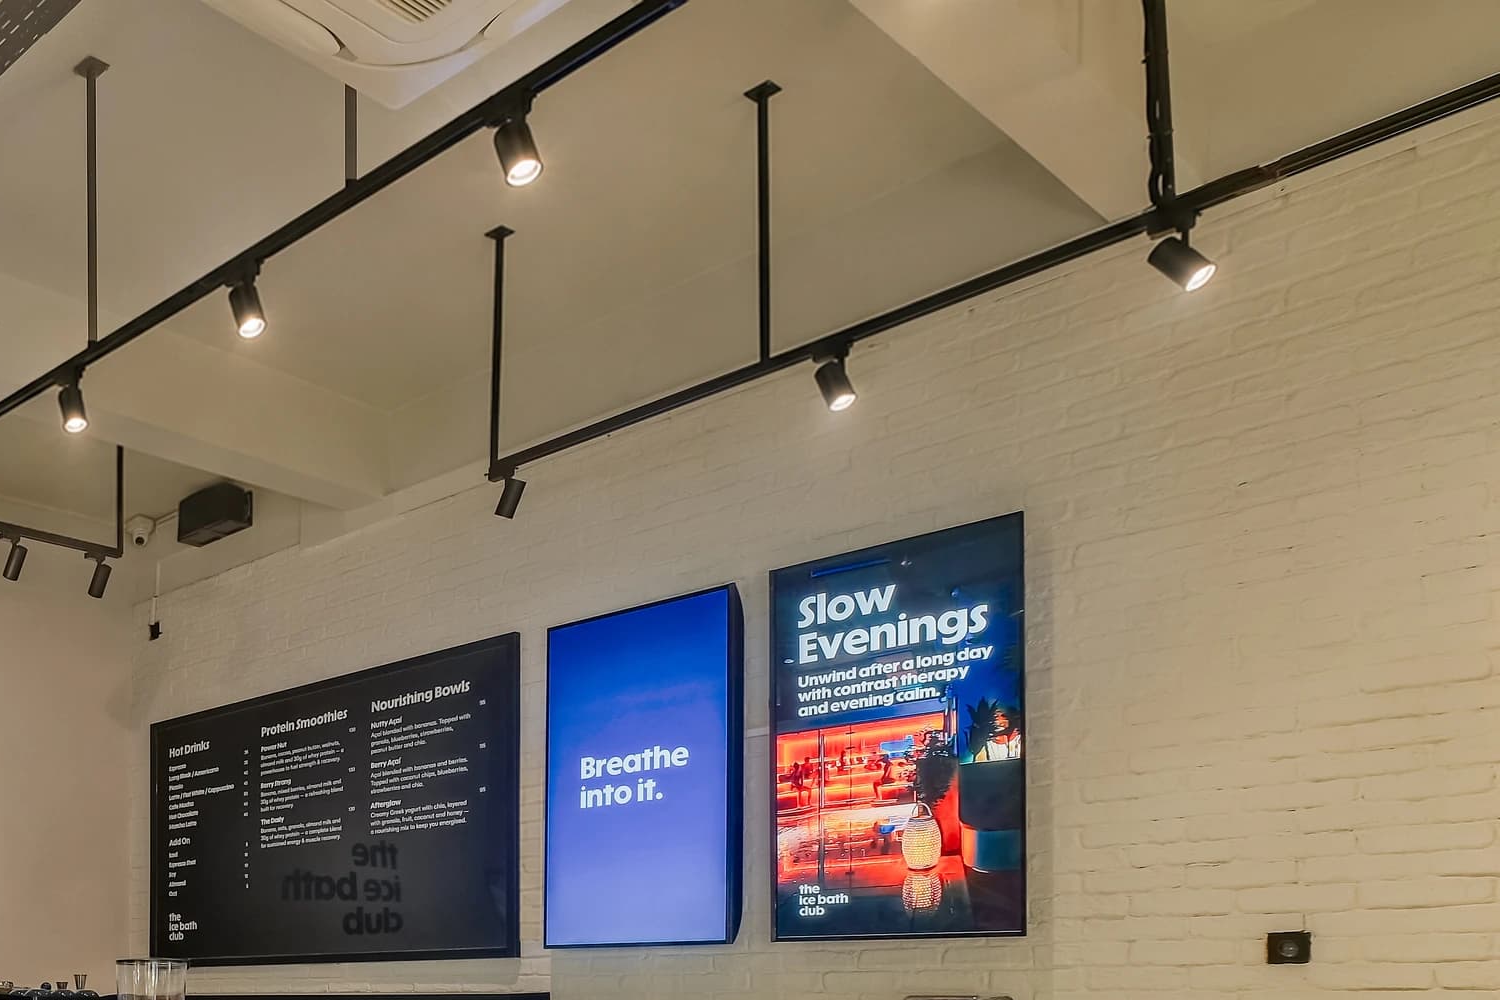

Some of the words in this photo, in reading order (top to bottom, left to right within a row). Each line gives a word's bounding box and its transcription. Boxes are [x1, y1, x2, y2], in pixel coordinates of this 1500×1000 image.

[797, 584, 896, 629] Slow
[799, 604, 989, 665] Evenings
[798, 666, 857, 687] Unwind
[858, 662, 900, 677] after
[902, 659, 914, 670] a
[916, 652, 954, 668] long
[957, 645, 993, 661] day
[798, 686, 831, 702] with
[833, 677, 899, 696] contrast
[900, 665, 970, 686] therapy
[371, 689, 433, 712] Nourishing
[434, 680, 470, 698] Bowls
[798, 701, 829, 717] and
[830, 692, 895, 709] evening
[896, 686, 941, 702] calm.
[261, 721, 295, 737] Protein
[296, 709, 348, 730] Smoothies
[371, 721, 387, 729] Nutty
[169, 746, 183, 758] Hot
[184, 740, 210, 755] Drinks
[581, 746, 689, 779] Breathe
[580, 784, 632, 808] into
[637, 778, 663, 802] it.
[370, 800, 401, 809] Afterglow
[169, 838, 181, 846] Add
[182, 837, 190, 845] On
[799, 884, 820, 894] the
[799, 895, 816, 905] ice
[818, 893, 849, 904] bath
[169, 912, 181, 921] the
[799, 906, 825, 916] club
[169, 922, 179, 931] ice
[180, 921, 197, 930] bath
[169, 931, 184, 941] club
